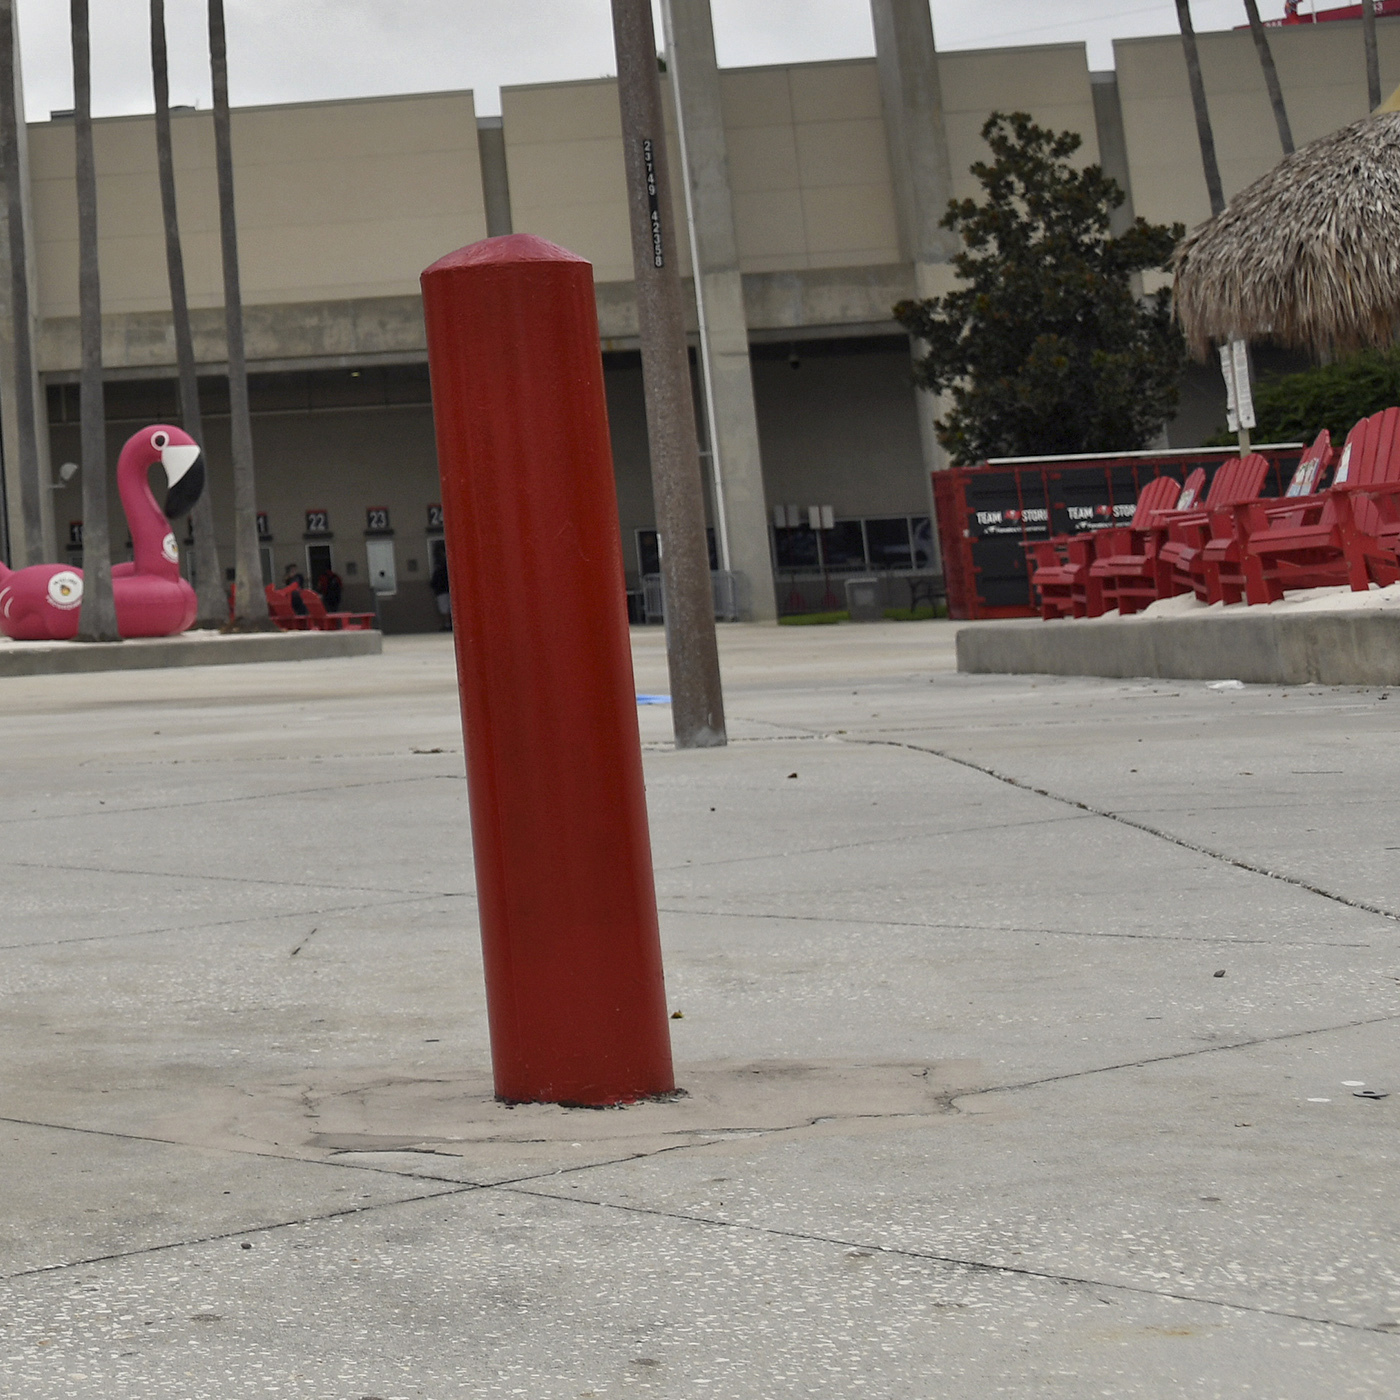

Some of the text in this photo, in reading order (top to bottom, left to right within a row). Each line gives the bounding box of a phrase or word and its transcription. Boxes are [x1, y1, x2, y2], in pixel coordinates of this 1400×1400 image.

[370, 511, 387, 528] 23
[976, 511, 1002, 524] TEAM
[1067, 506, 1093, 520] TEAM
[308, 513, 326, 531] 22
